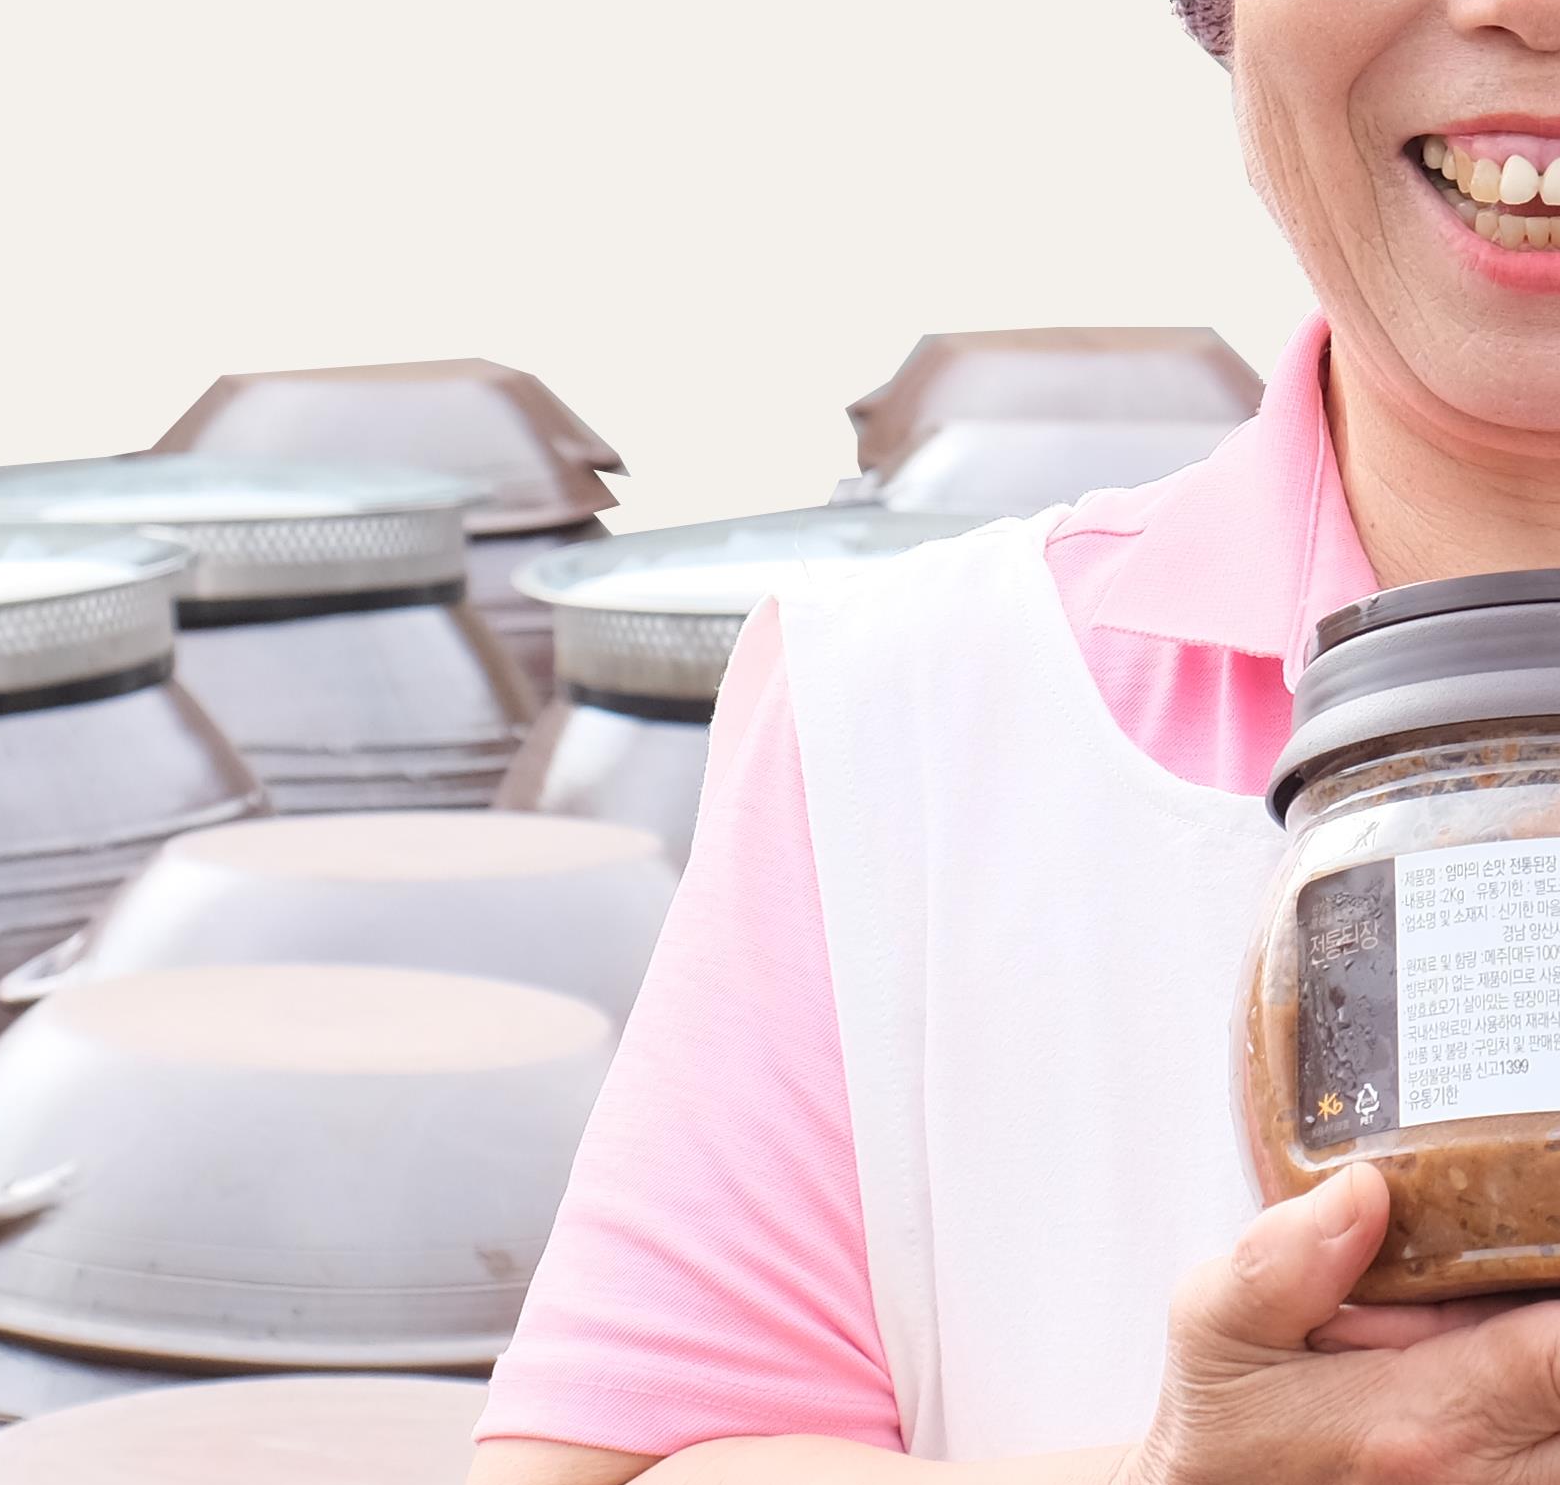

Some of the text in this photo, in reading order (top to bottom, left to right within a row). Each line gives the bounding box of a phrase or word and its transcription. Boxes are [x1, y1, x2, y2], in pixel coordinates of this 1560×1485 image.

[1445, 862, 1479, 882] 엄마의
[1482, 858, 1506, 878] 손맛
[1509, 856, 1557, 875] 전통된장
[1439, 909, 1450, 927] 및
[1454, 905, 1488, 925] 소재지
[1498, 900, 1534, 920] 신기한
[1537, 898, 1560, 916] 마을
[1310, 921, 1381, 965] 전통된장
[1502, 923, 1526, 942] 경남
[1452, 974, 1474, 993] 없는
[1477, 968, 1536, 988] 제품이므로
[1463, 993, 1509, 1012] 살아있는
[1513, 988, 1560, 1008] 된장이라
[1475, 1014, 1522, 1034] 사용하여
[1525, 1010, 1560, 1028] 재래식
[1431, 1044, 1442, 1063] 및
[1513, 1035, 1525, 1054] 및
[1476, 1057, 1529, 1079] 신고1399
